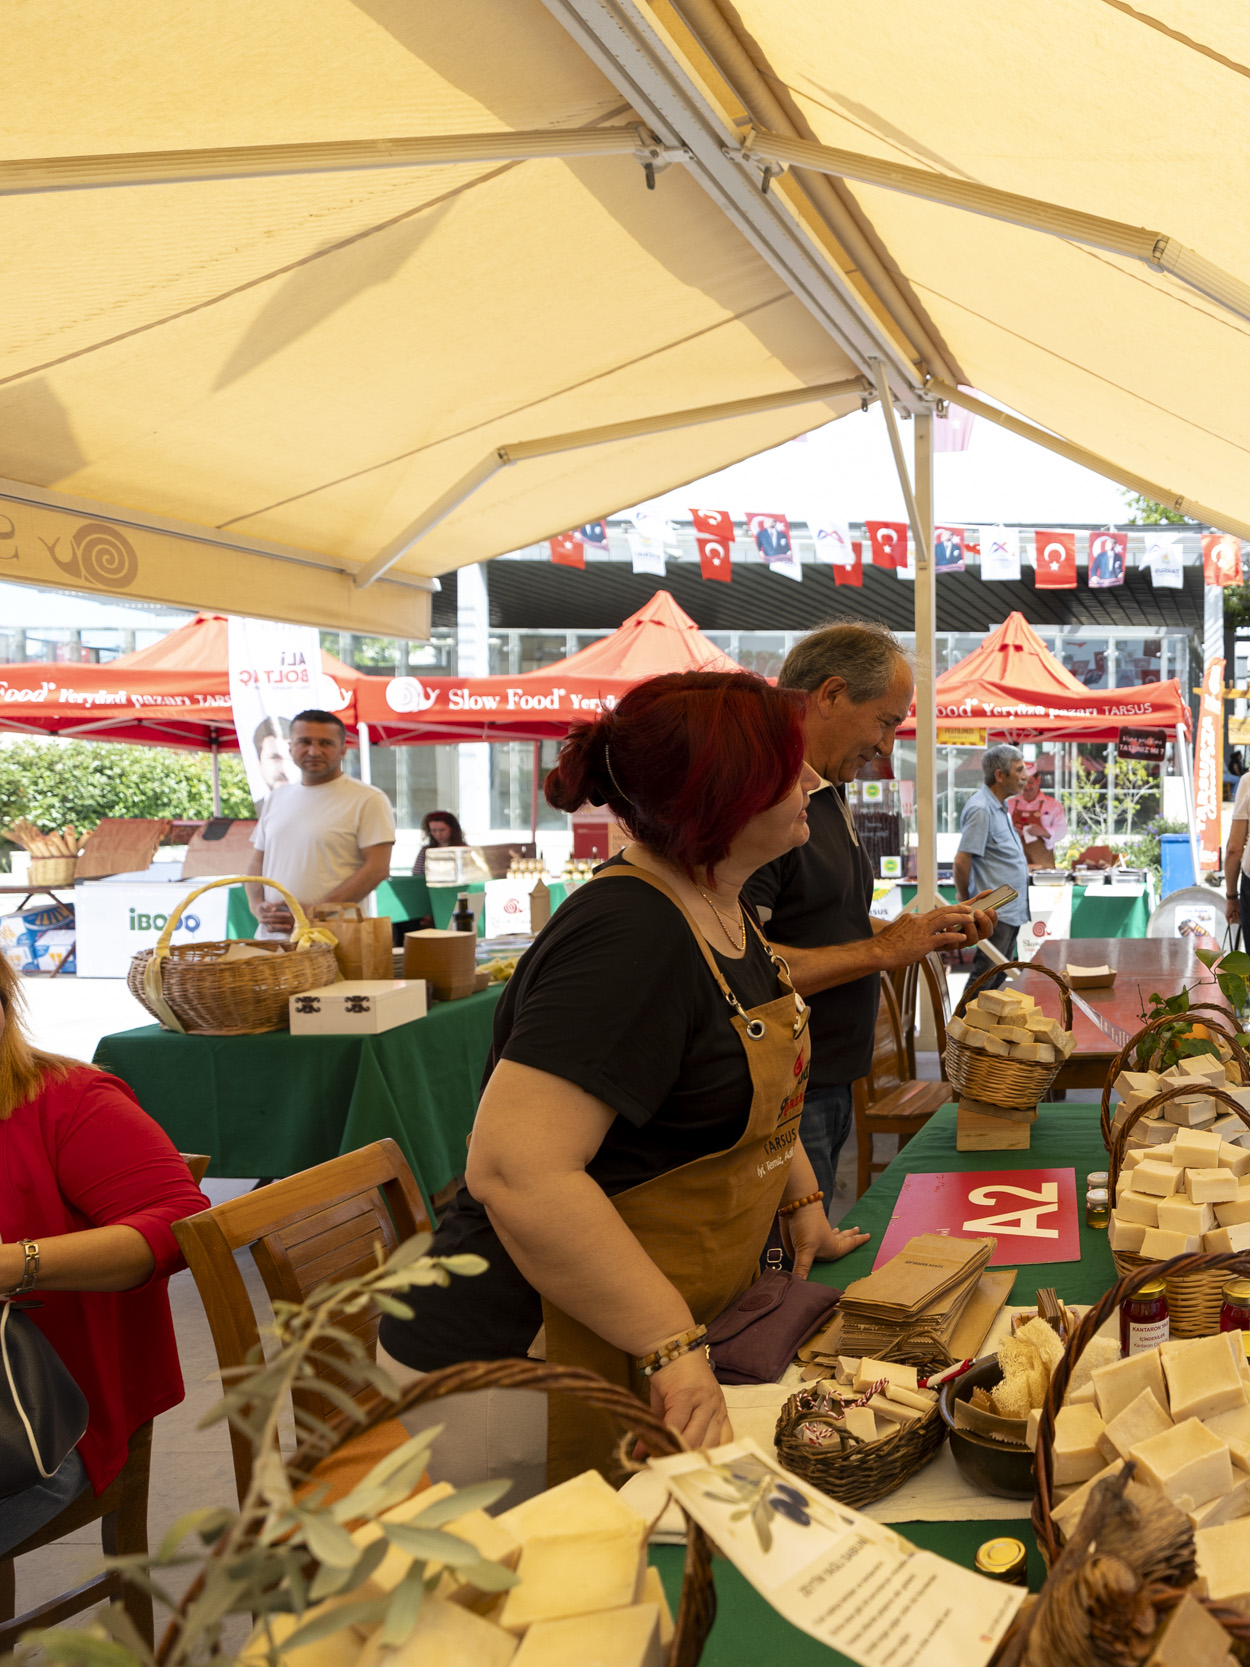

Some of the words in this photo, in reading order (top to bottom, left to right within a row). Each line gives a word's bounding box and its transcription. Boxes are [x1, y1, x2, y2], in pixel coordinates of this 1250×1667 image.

[448, 688, 500, 710] Slow
[1102, 702, 1153, 716] TARSUS
[763, 1127, 797, 1155] TARSUS
[962, 1182, 1059, 1239] A2
[1132, 1324, 1161, 1333] KANTARON
